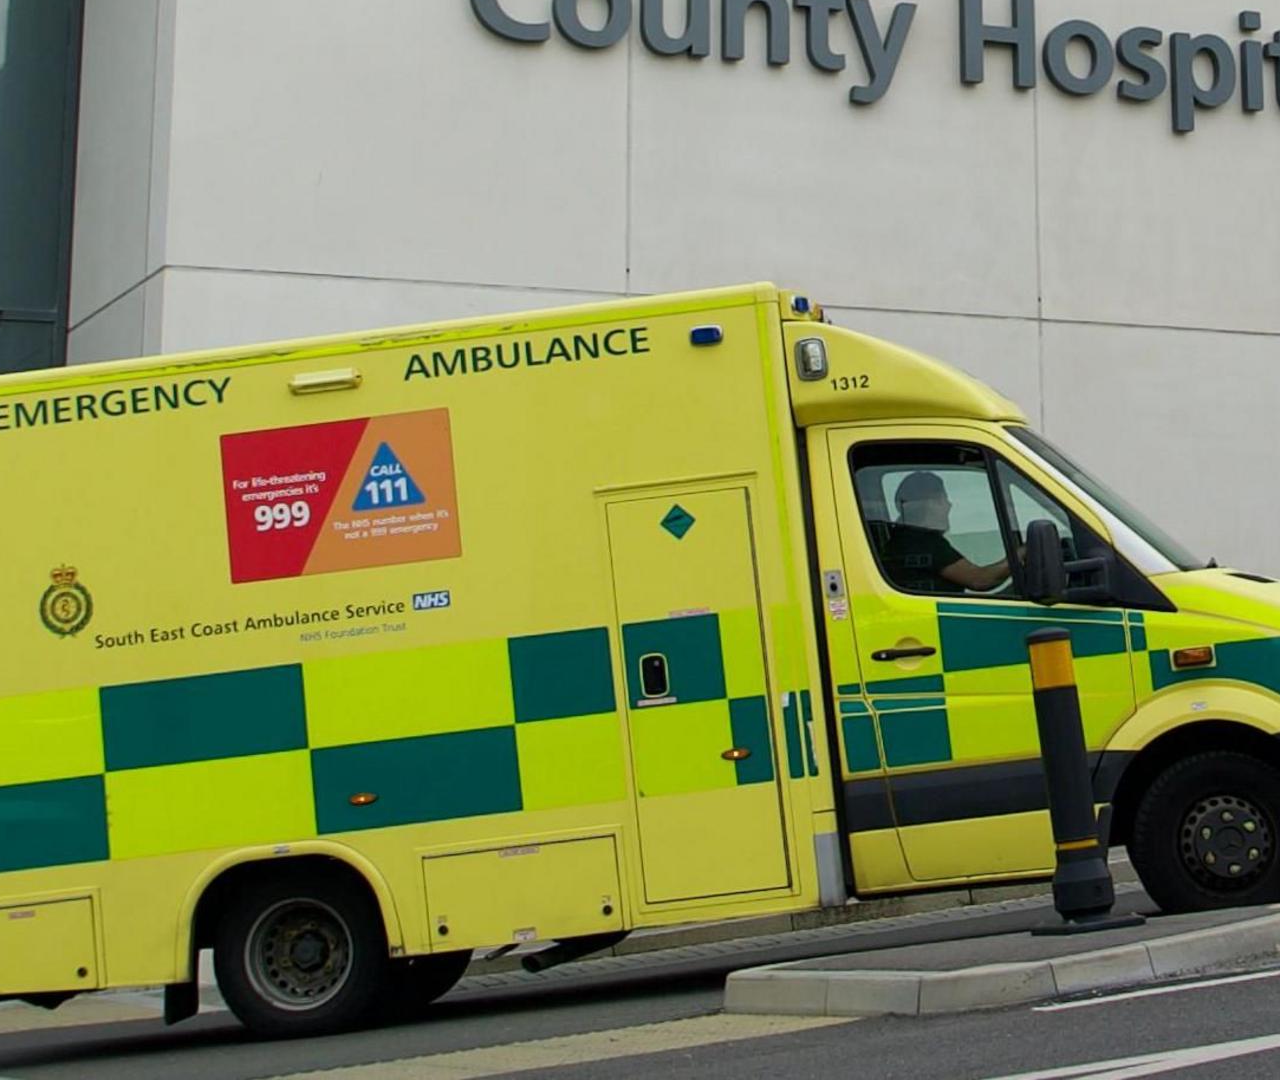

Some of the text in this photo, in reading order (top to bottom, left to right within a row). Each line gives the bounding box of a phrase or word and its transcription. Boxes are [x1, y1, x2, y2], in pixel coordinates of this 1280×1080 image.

[404, 327, 651, 381] AMBULANCE
[830, 374, 870, 391] 1312
[233, 470, 326, 490] For life-threatening
[370, 463, 403, 477] CALL
[242, 487, 304, 502] emergencies
[365, 477, 409, 504] 111
[254, 500, 310, 532] 999
[413, 592, 450, 610] NHS
[95, 599, 406, 649] South East Coast Ambulance Service
[300, 621, 407, 642] NHS Foundation Trust
